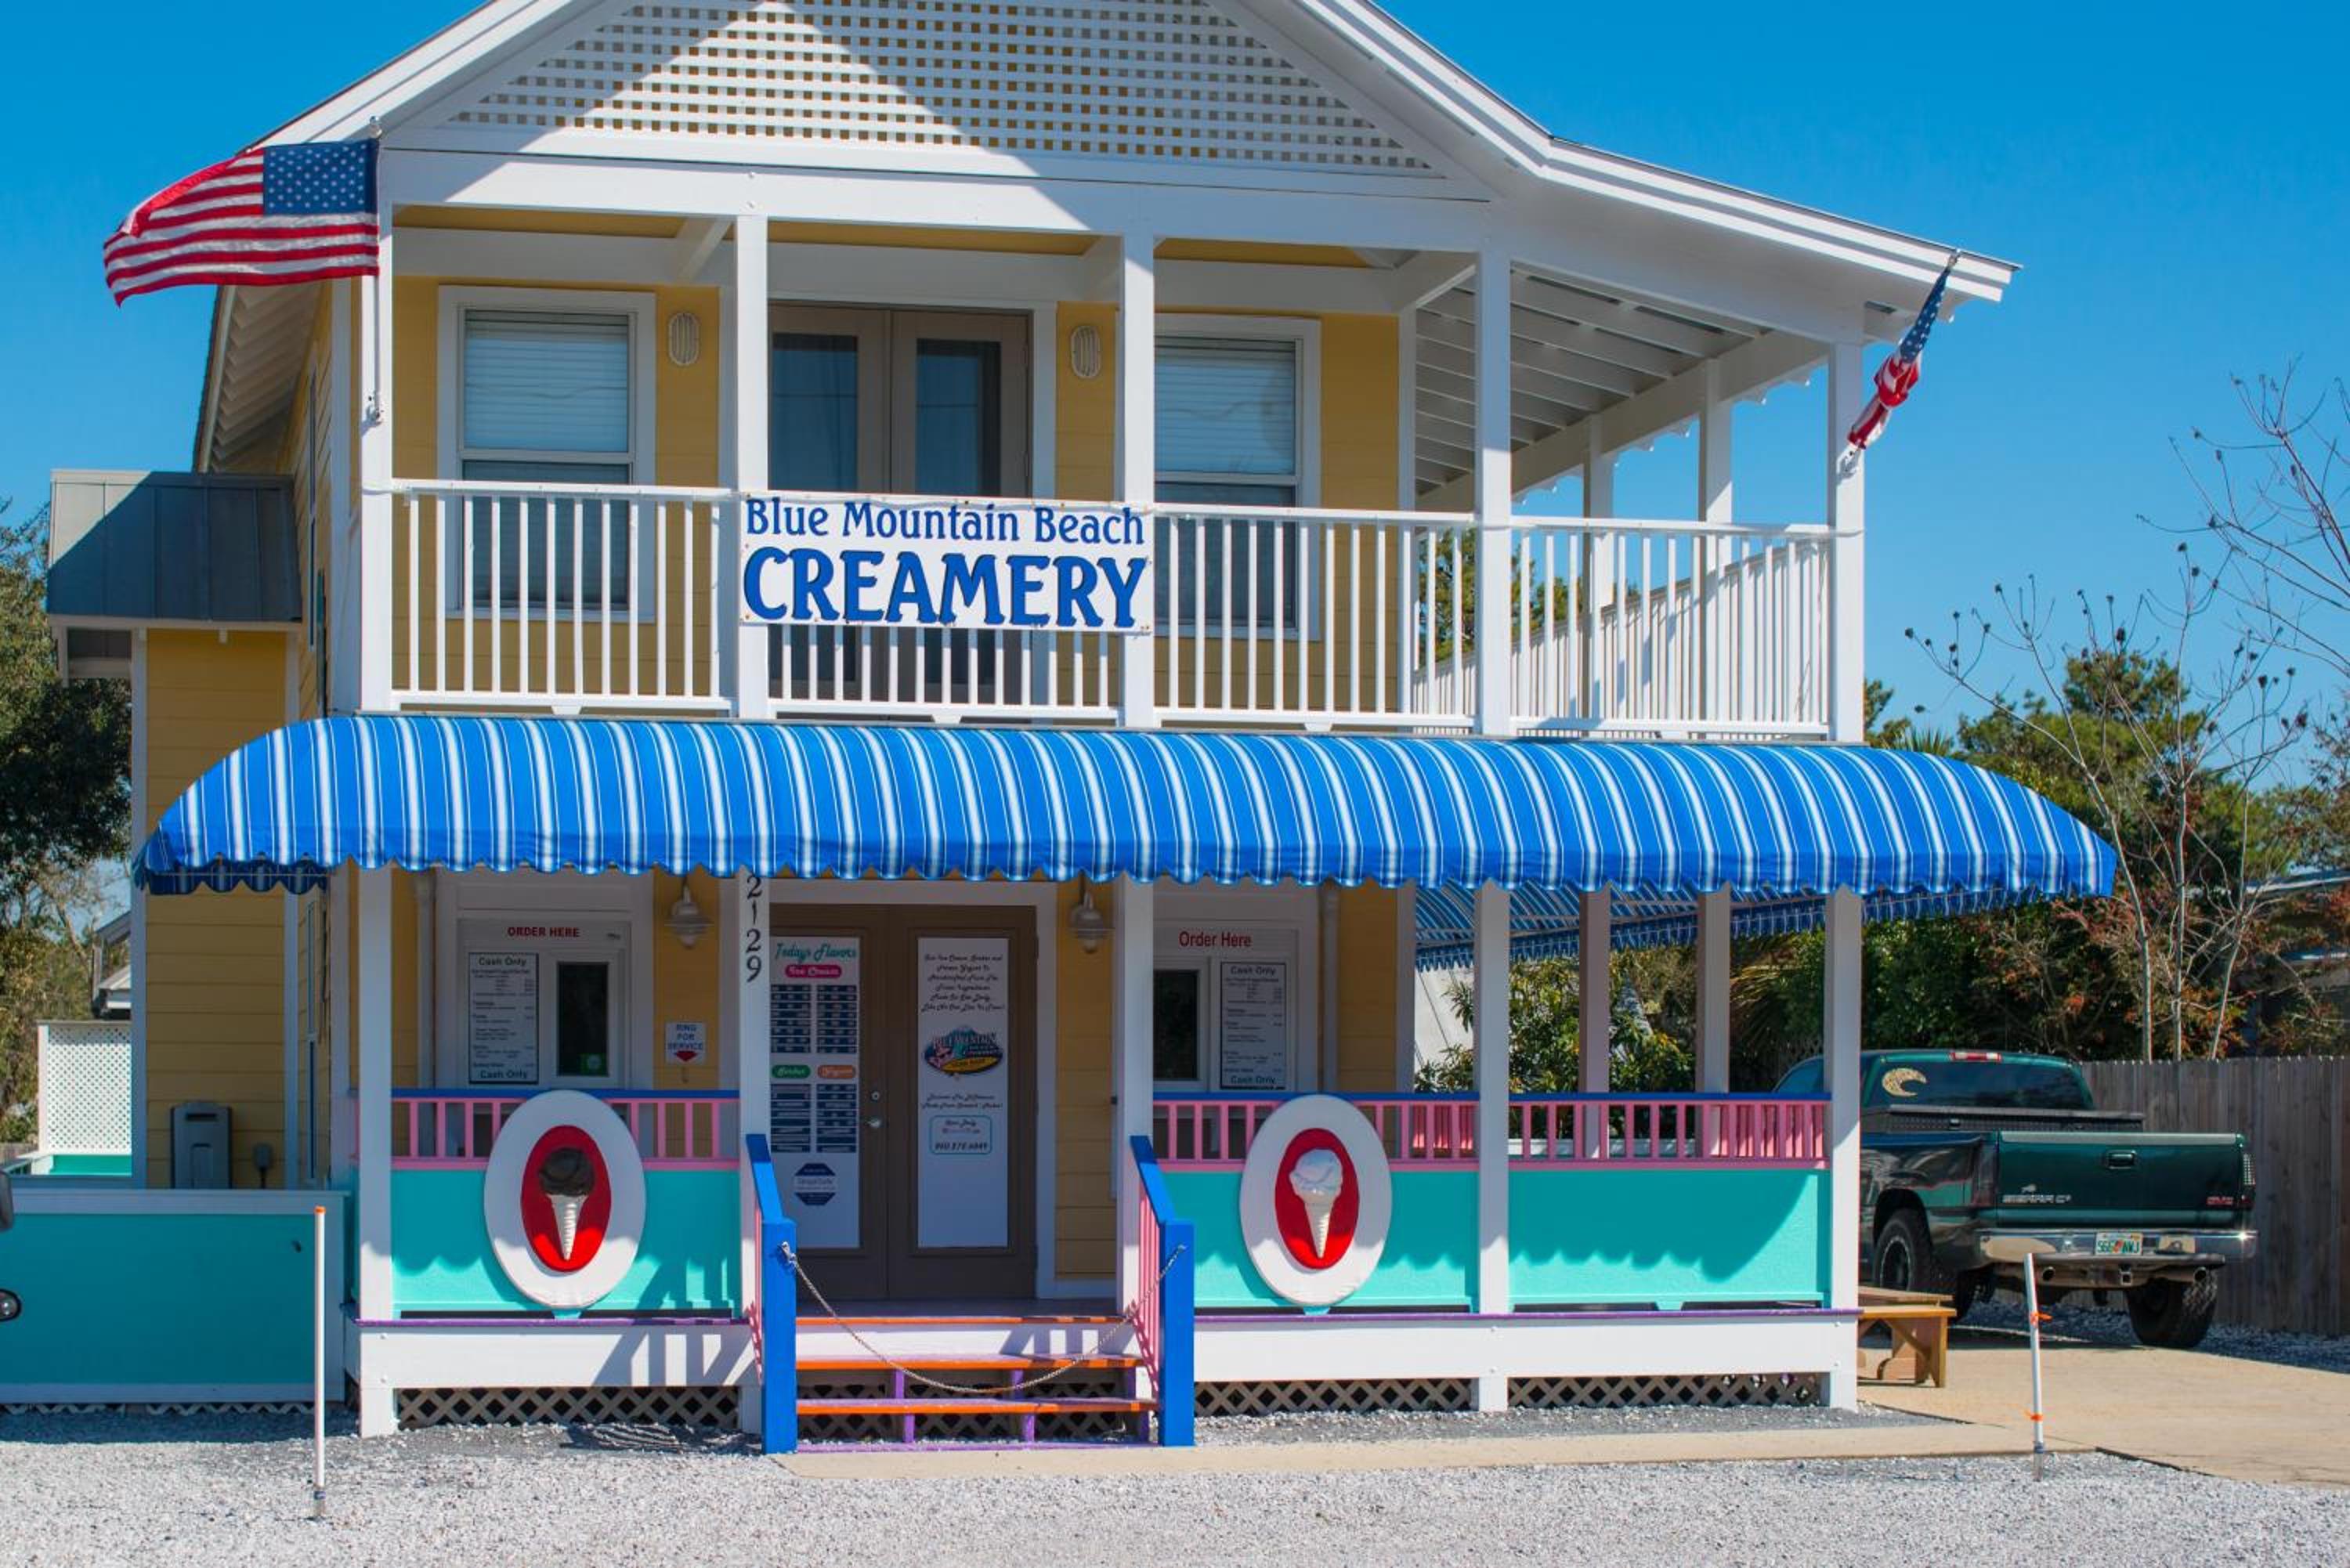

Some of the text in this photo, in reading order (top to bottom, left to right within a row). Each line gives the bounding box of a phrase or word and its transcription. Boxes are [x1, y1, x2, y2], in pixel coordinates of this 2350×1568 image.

[747, 498, 1145, 545] Blue Mountain Beach
[743, 546, 1146, 627] CREAMERY
[507, 927, 580, 938] ORDER HERE
[746, 875, 763, 983] 2129
[1179, 930, 1251, 947] Order Here
[478, 956, 528, 967] Cash Only
[479, 1070, 504, 1079] Cash
